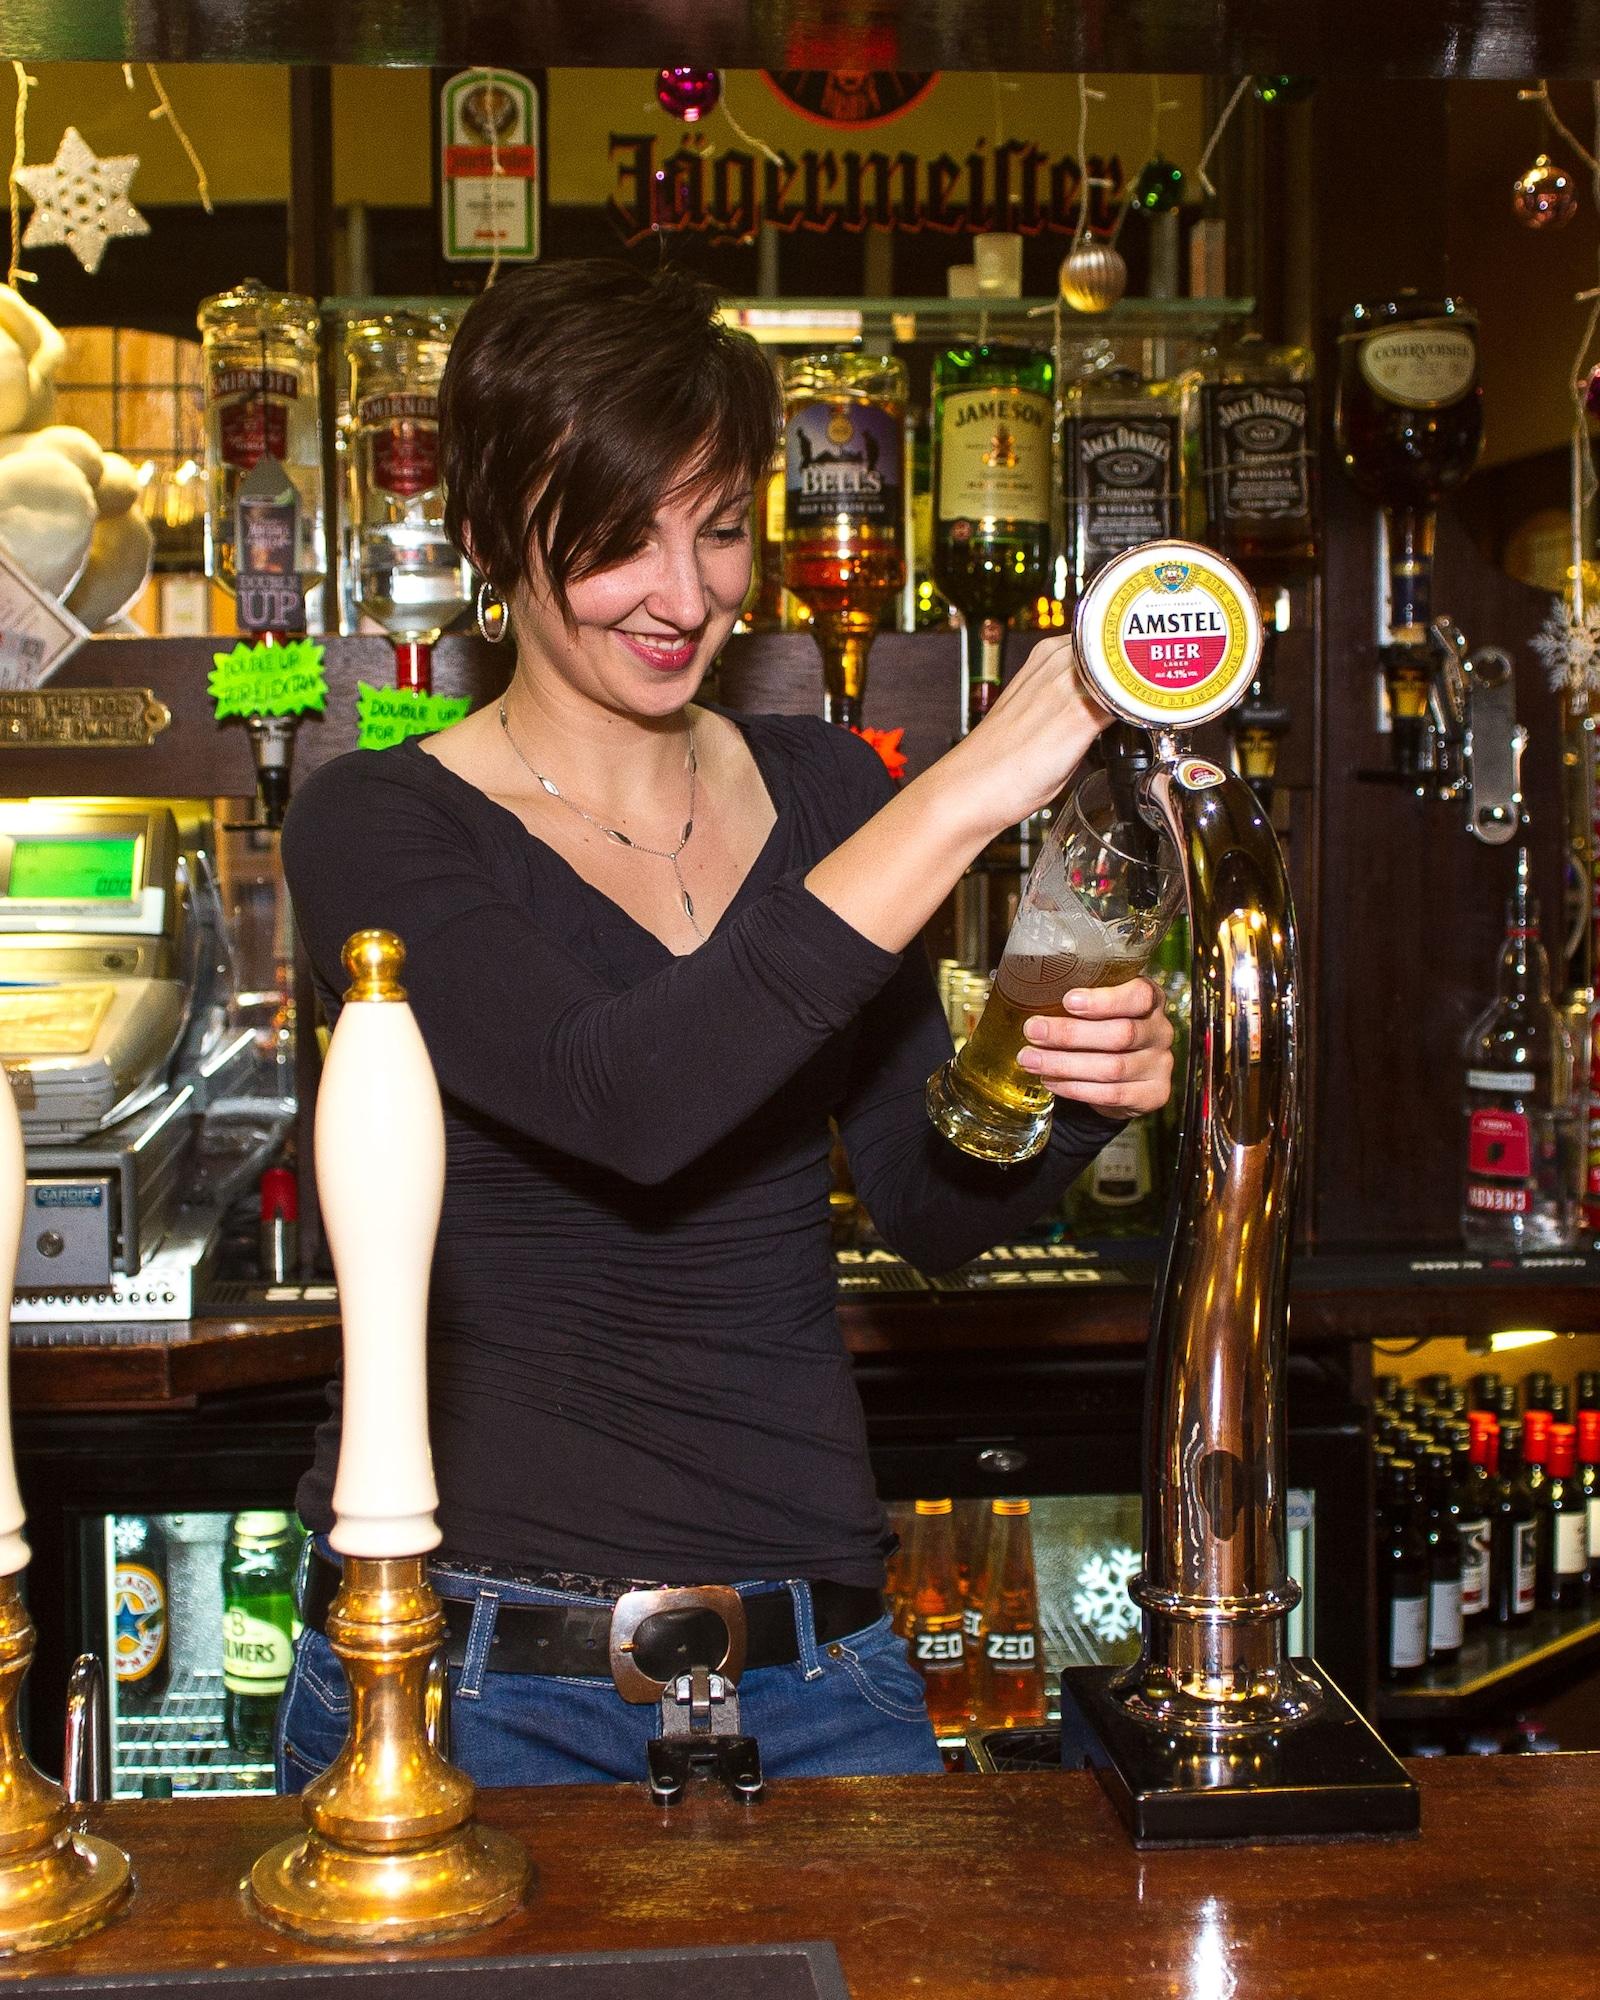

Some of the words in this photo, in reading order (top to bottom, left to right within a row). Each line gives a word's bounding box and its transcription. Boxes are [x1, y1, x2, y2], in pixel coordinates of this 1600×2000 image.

[955, 400, 1043, 427] JAMESON
[1081, 431, 1118, 463] JACK
[241, 588, 299, 626] UP
[1127, 611, 1221, 635] AMSTEL
[1151, 643, 1200, 660] BIER
[1166, 669, 1188, 680] 4.1%
[370, 700, 429, 721] DOUBLE
[366, 724, 395, 740] FOR
[917, 1633, 964, 1660] ZED
[986, 1633, 1035, 1660] ZED
